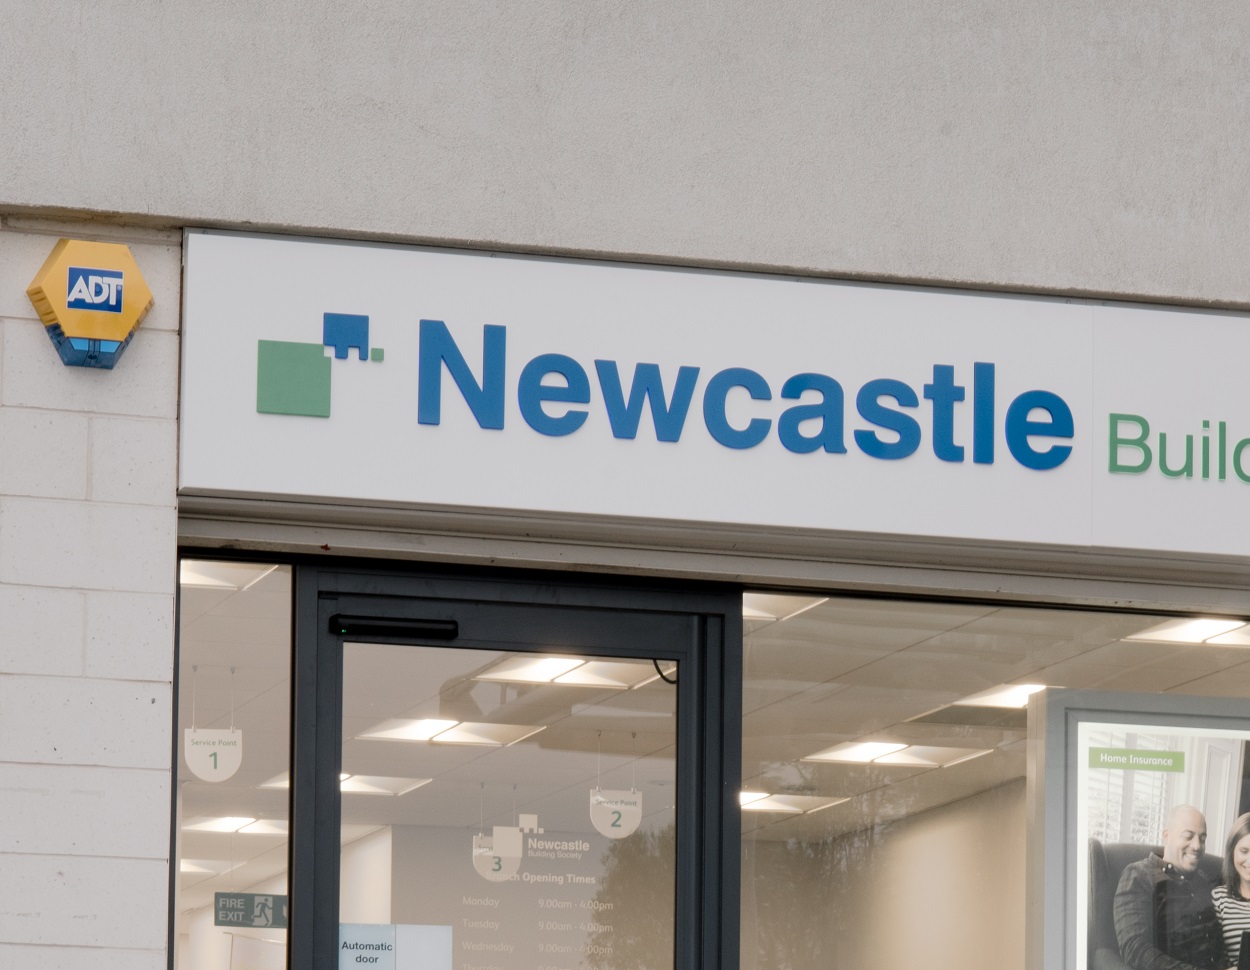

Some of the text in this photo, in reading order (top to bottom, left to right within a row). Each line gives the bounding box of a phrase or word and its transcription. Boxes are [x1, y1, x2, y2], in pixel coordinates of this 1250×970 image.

[67, 275, 123, 306] ADT
[417, 318, 1075, 471] Newcastle
[190, 738, 237, 747] Service Point
[208, 751, 218, 770] 1
[1099, 752, 1173, 767] Home Insurance
[619, 799, 637, 807] Point
[610, 810, 623, 828] 2
[527, 838, 590, 851] Newcastle
[527, 850, 583, 860] Building Society
[491, 855, 502, 872] 3
[522, 872, 564, 885] Opening
[566, 873, 597, 885] Times
[218, 898, 245, 909] FIRE
[462, 896, 614, 912] Monday 9.00am 4.00pm
[218, 911, 245, 922] EXIT
[462, 919, 614, 934] Tuesday 9.00am 4.00pm
[341, 941, 393, 952] Automatic
[462, 941, 515, 954] Wednesday
[538, 943, 572, 953] 9.00am
[355, 953, 380, 964] door
